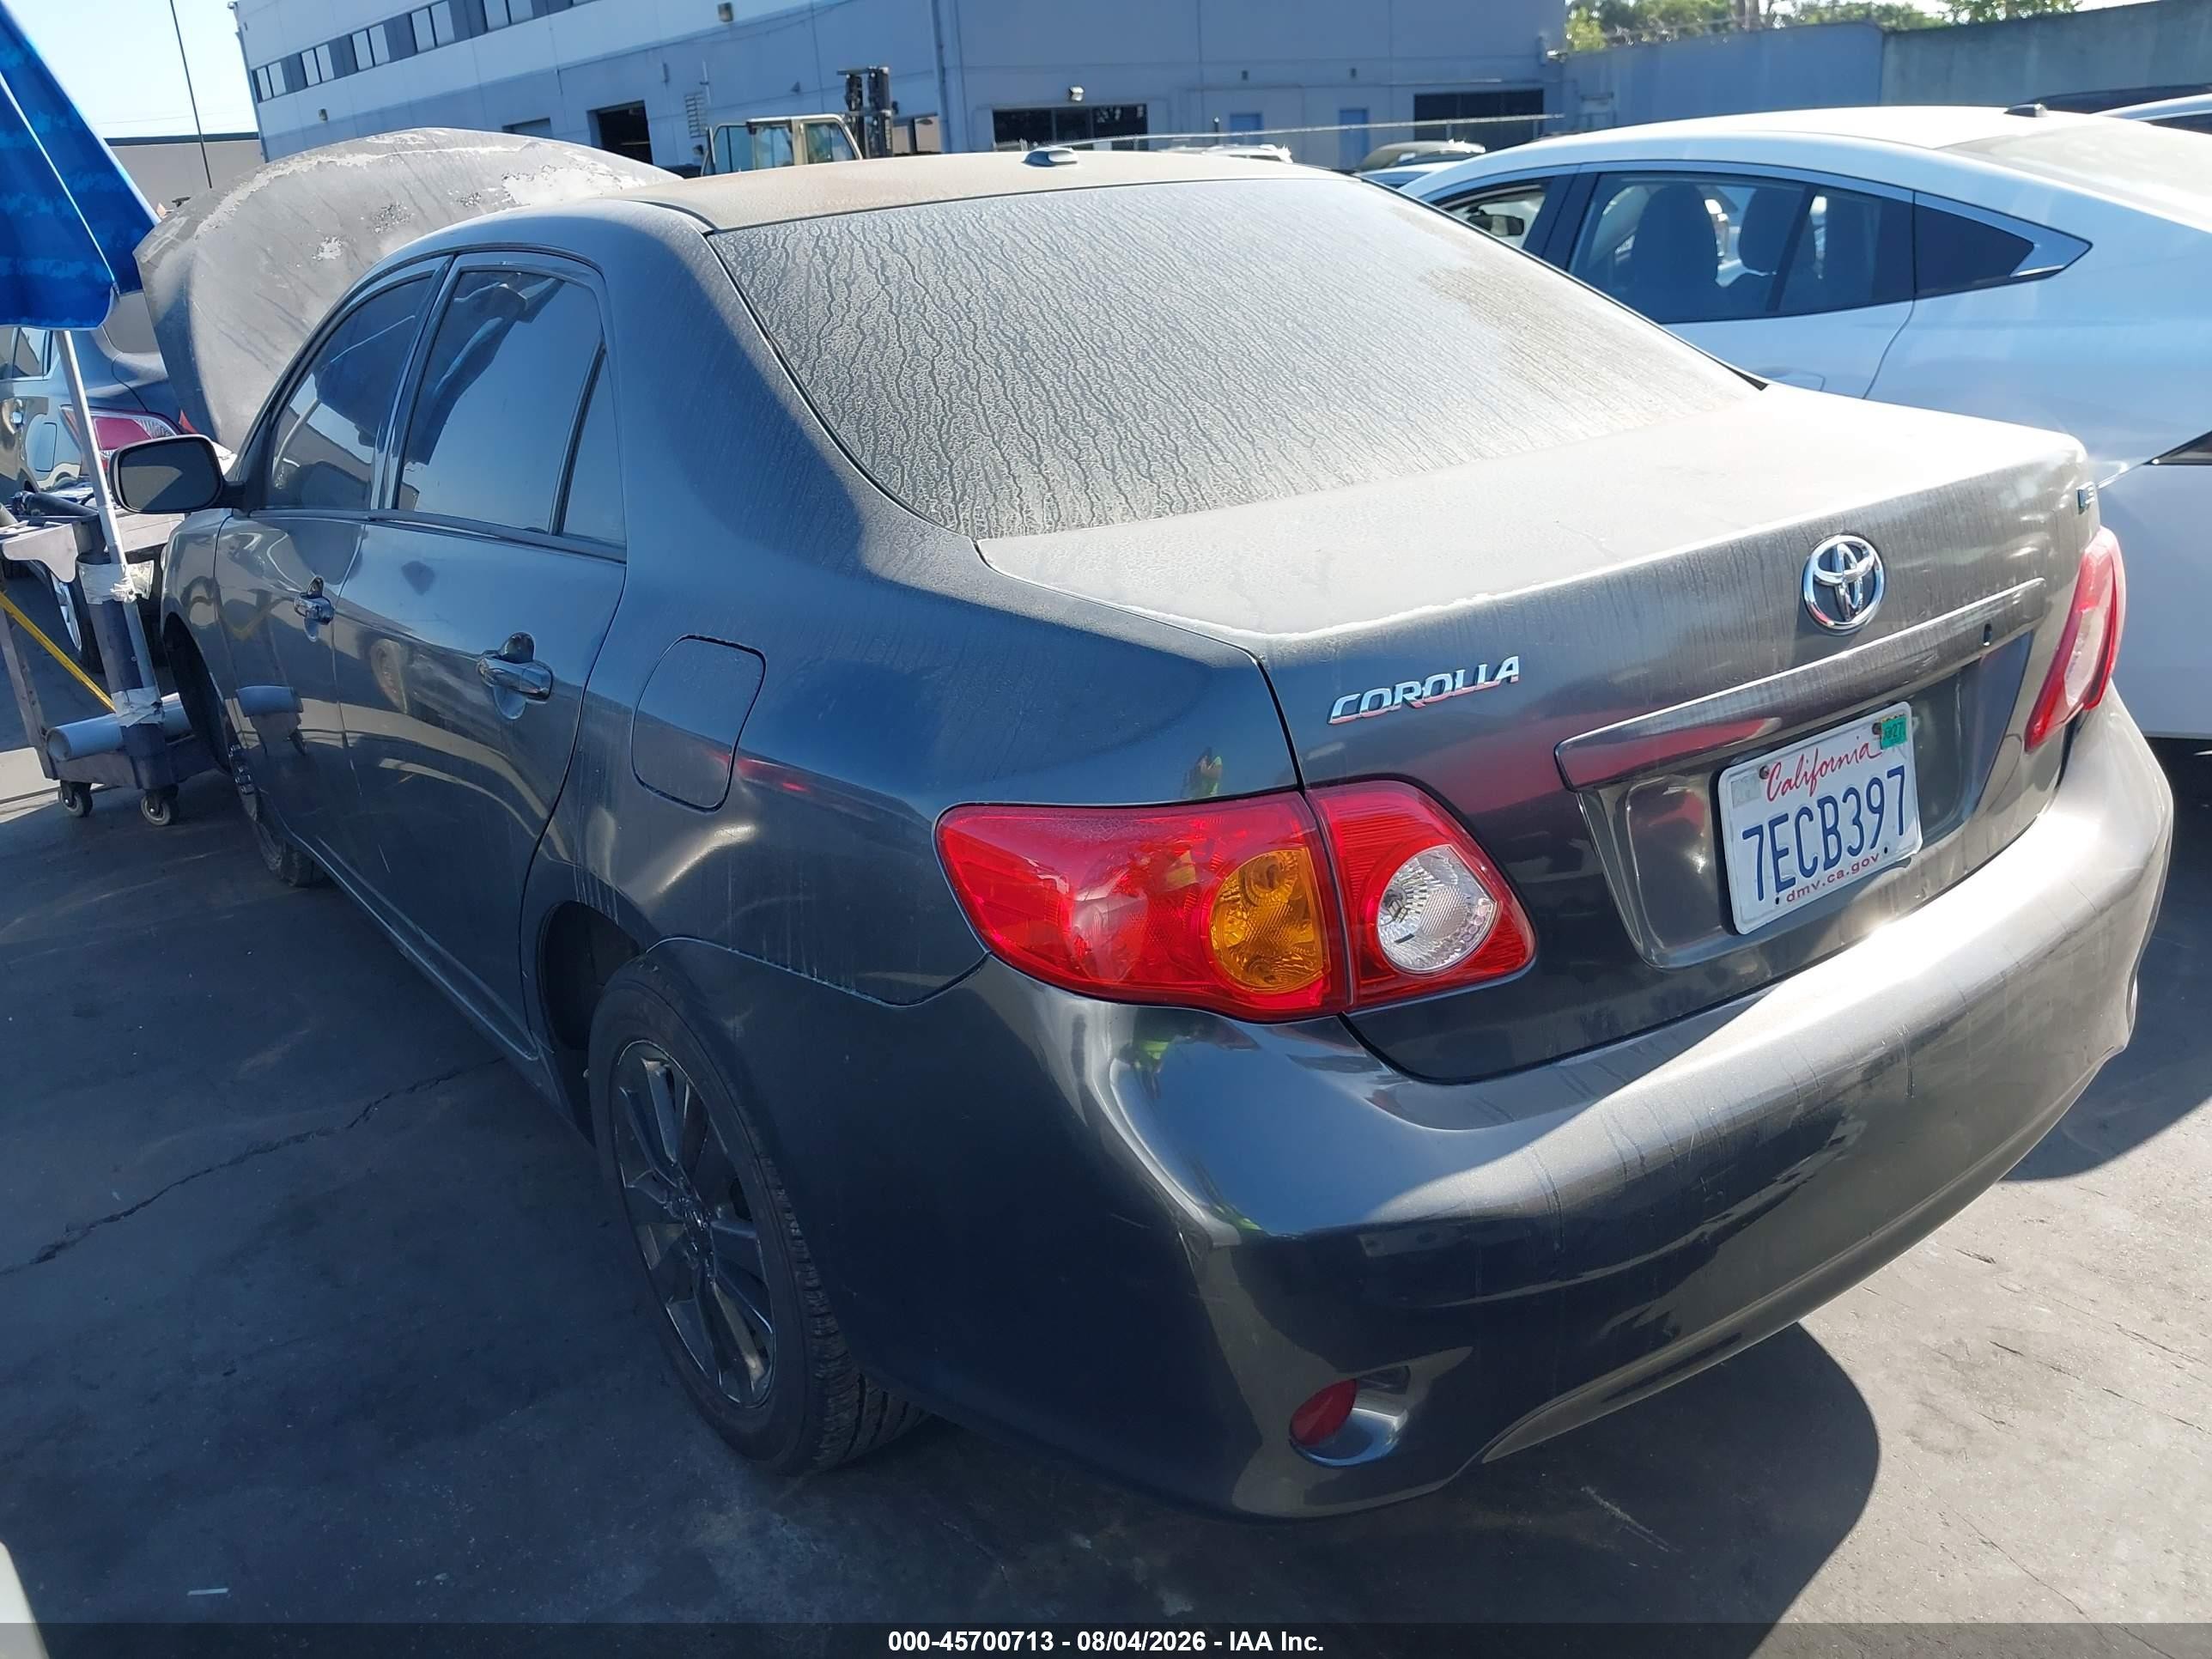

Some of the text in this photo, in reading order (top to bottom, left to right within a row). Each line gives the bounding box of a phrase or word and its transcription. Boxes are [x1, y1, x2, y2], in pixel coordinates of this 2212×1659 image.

[1328, 655, 1520, 725] COROLLA
[1766, 735, 1882, 802] California
[1741, 765, 1905, 902] 7ECB397
[1786, 853, 1880, 903] dmv.ca.gov
